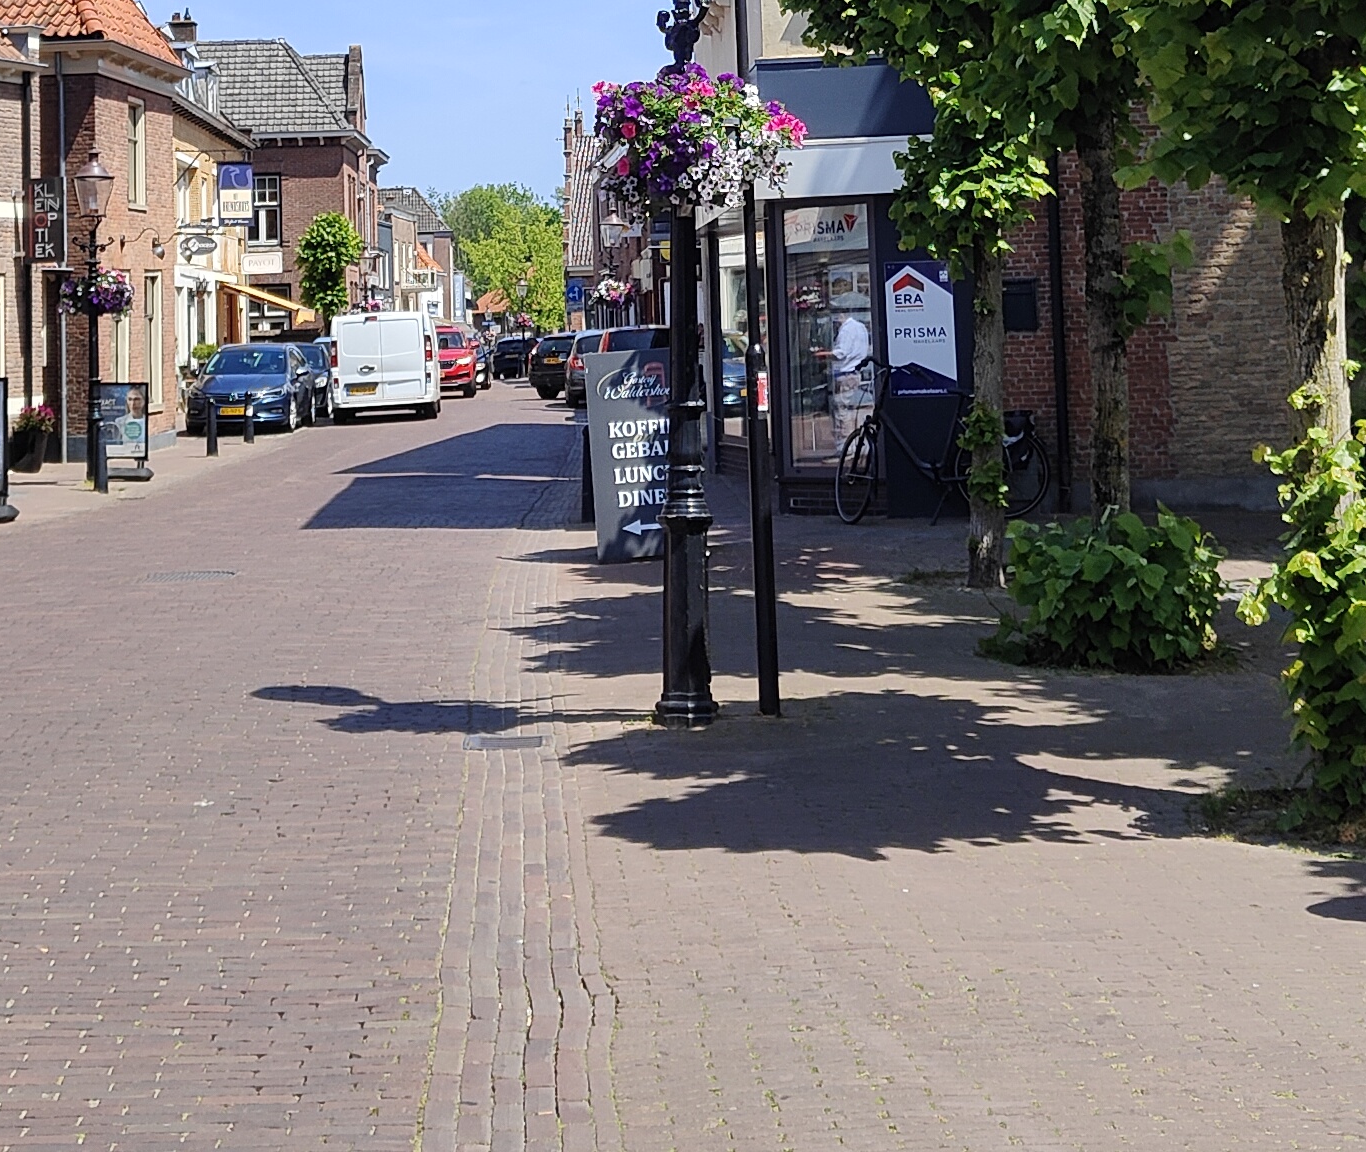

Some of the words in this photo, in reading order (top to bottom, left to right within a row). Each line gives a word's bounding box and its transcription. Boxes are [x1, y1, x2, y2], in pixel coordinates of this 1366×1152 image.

[248, 259, 274, 267] PAYOT
[895, 293, 923, 304] ERA
[894, 327, 947, 338] PRISMA
[618, 488, 669, 508] DINE
